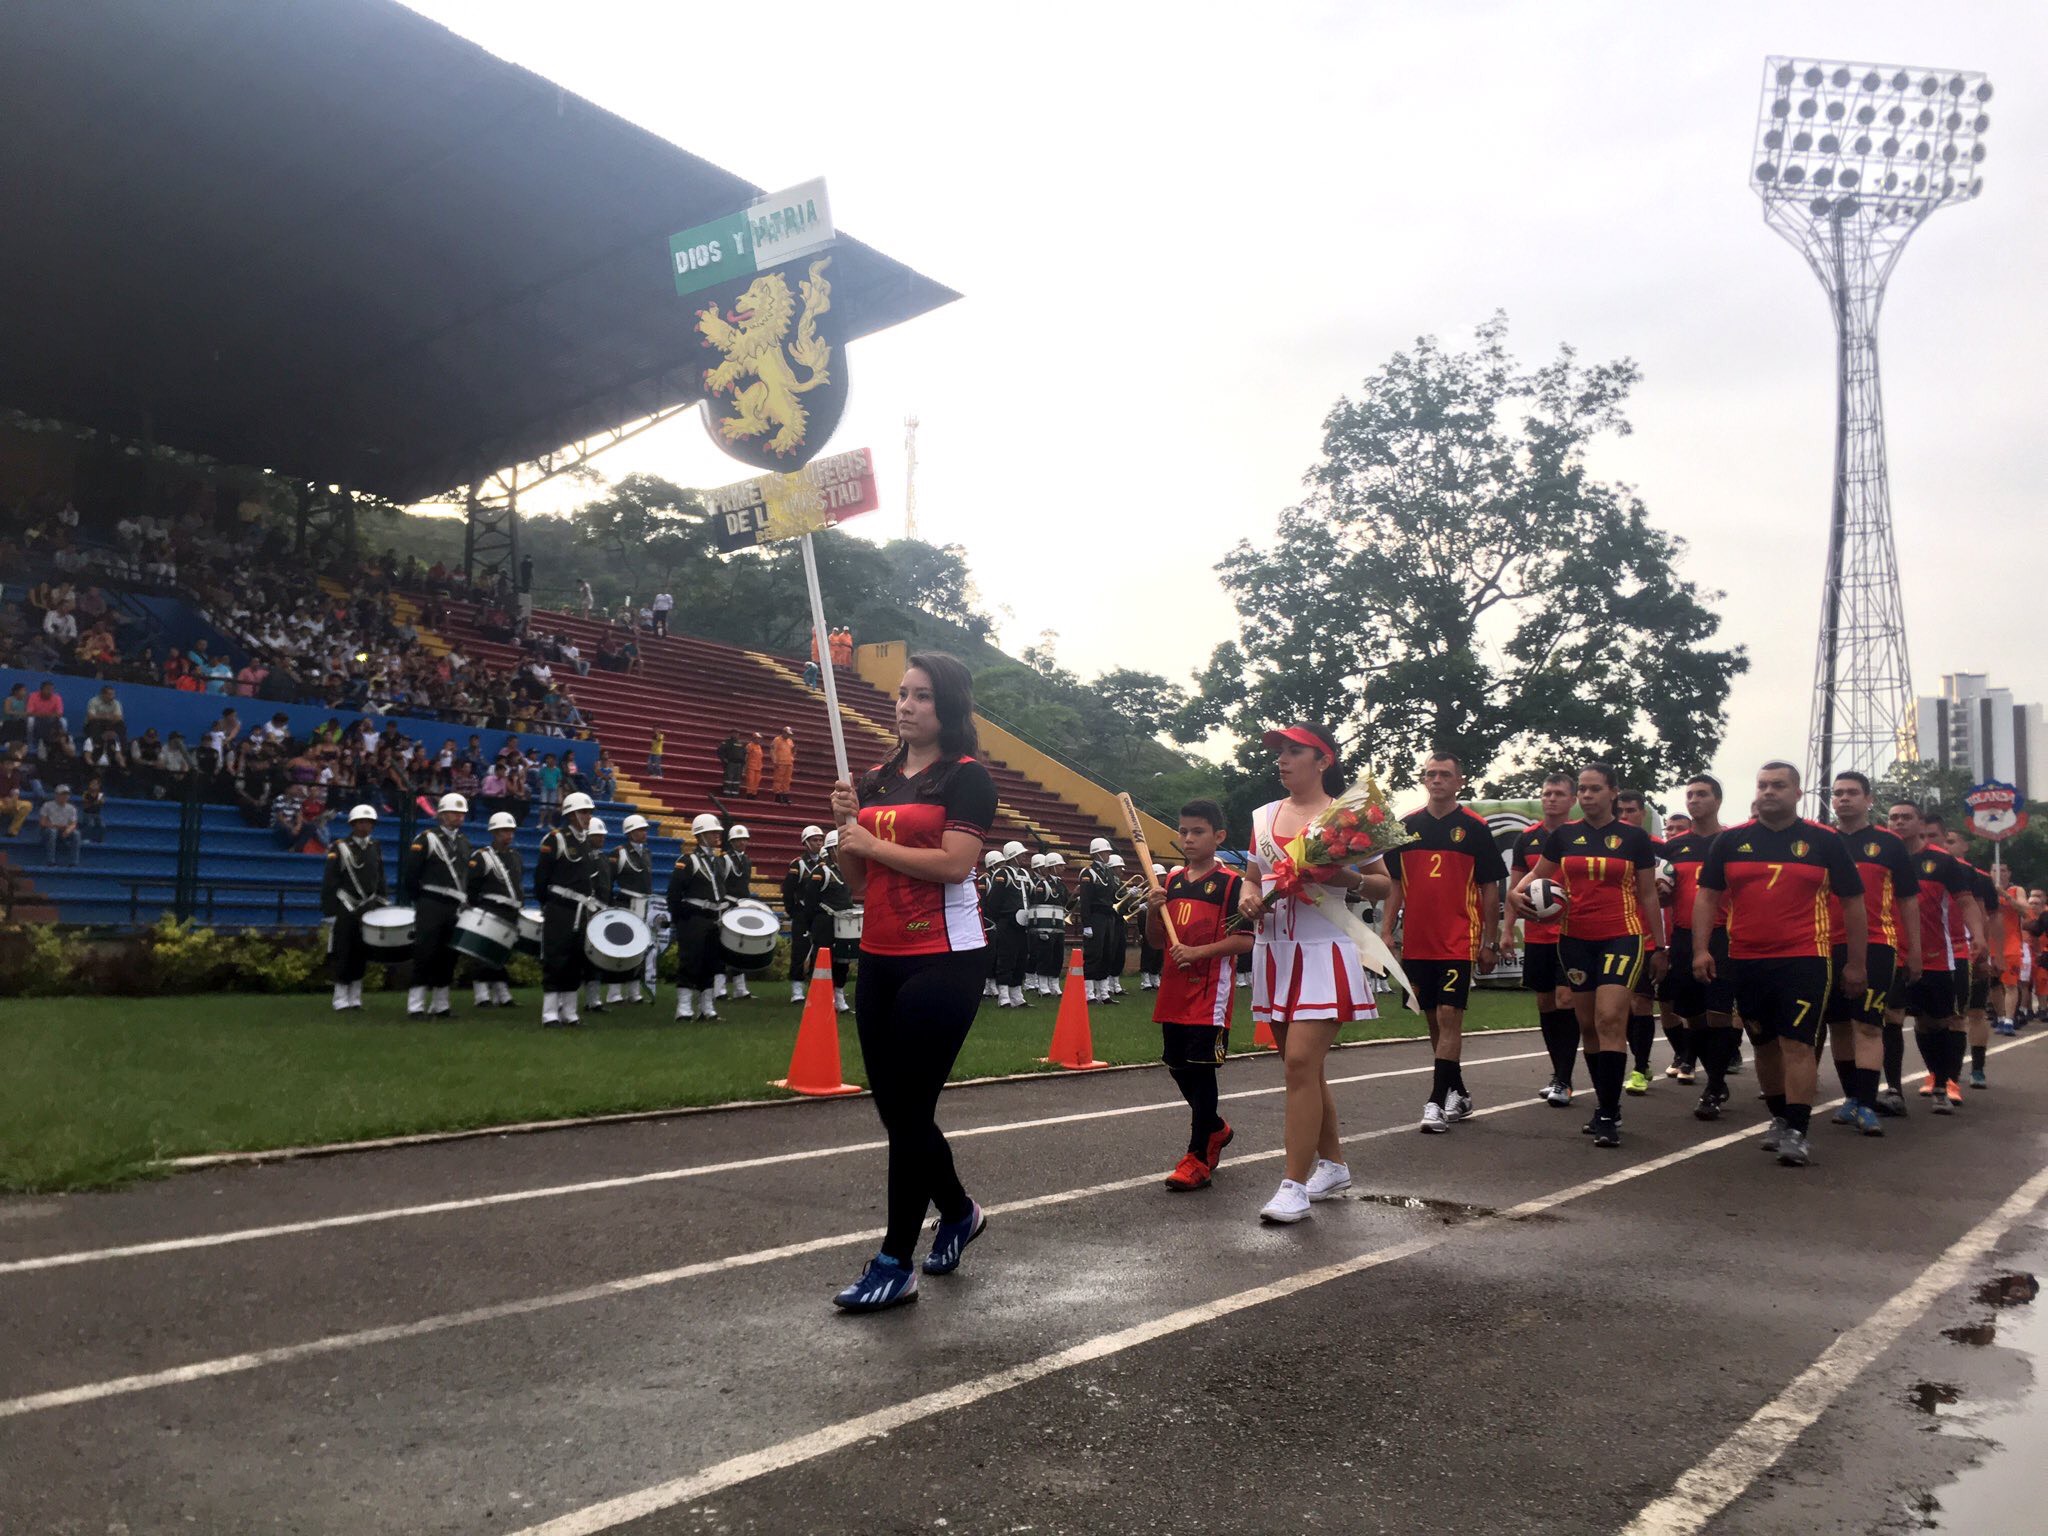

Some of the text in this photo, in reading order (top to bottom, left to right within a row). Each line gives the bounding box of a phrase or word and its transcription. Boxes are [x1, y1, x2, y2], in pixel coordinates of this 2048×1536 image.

[675, 199, 818, 275] DIOS Y PATRIA
[725, 509, 752, 536] DE
[875, 810, 897, 843] 13
[1429, 853, 1442, 878] 2
[1585, 856, 1607, 881] 11
[1767, 864, 1783, 890] 7
[1176, 901, 1192, 926] 10
[1603, 953, 1631, 976] 11
[1443, 969, 1459, 993] 2
[1792, 999, 1811, 1027] 7
[1863, 988, 1886, 1013] 14
